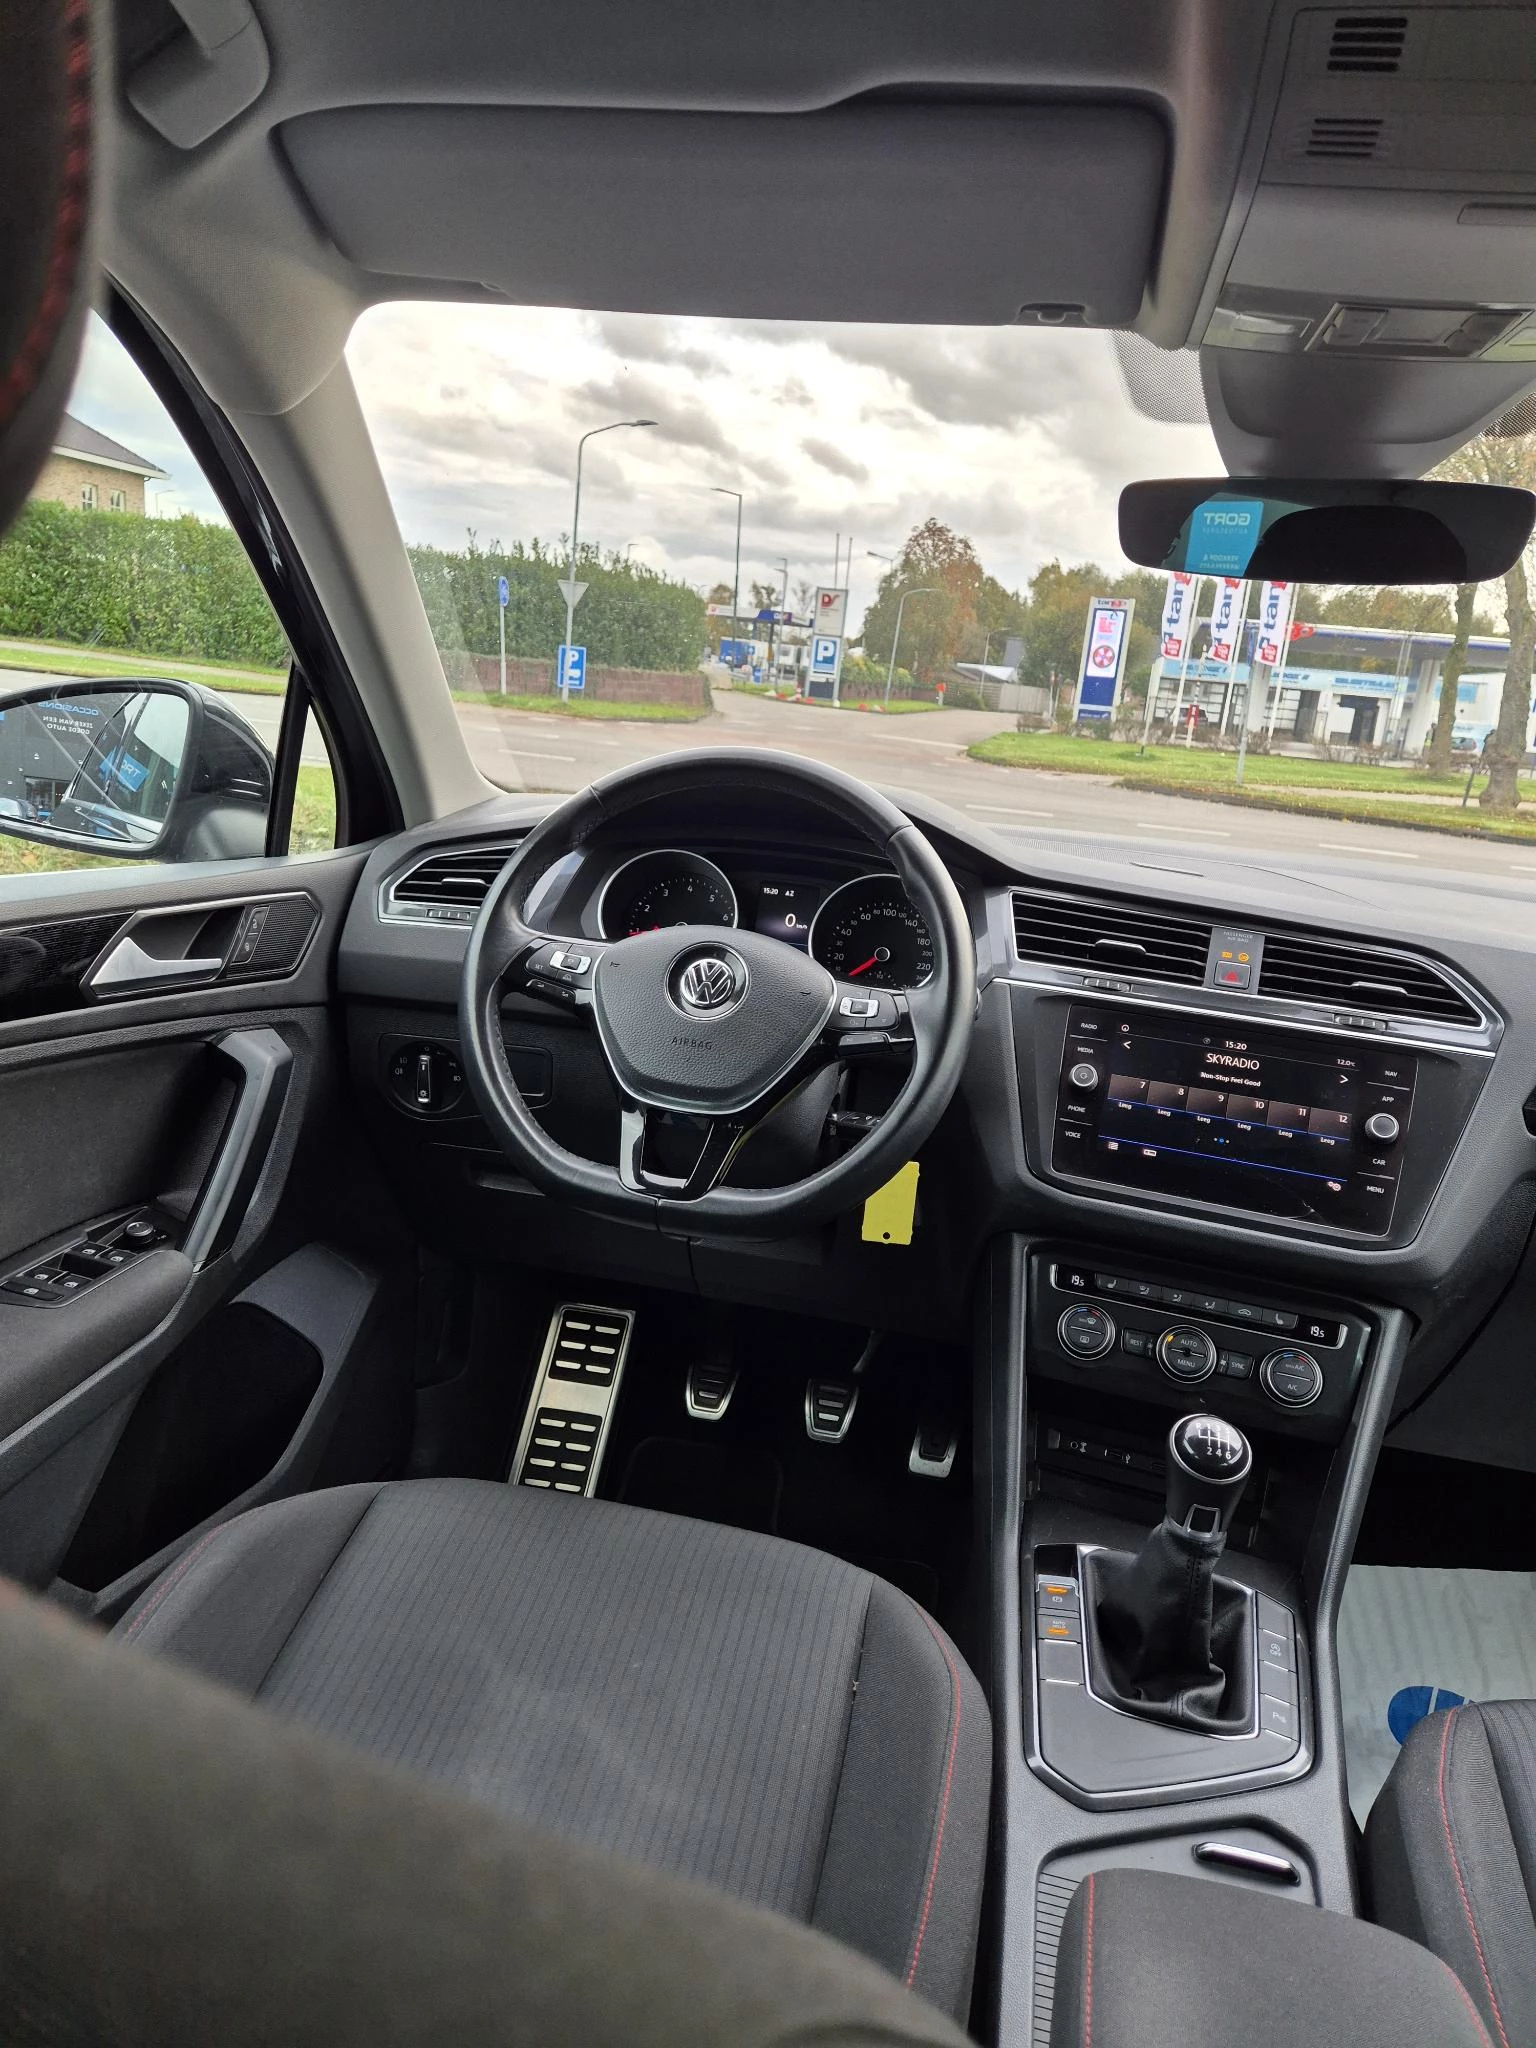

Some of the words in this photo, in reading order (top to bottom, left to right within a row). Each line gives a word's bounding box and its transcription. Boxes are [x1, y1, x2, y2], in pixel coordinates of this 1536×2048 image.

[817, 640, 836, 662] P
[663, 889, 669, 897] 3
[687, 885, 693, 893] 4
[644, 904, 650, 912] 2
[883, 908, 897, 917] 100
[785, 913, 796, 927] 0
[860, 913, 872, 921] 60
[904, 919, 918, 927] 140
[841, 928, 852, 936] 40
[917, 938, 931, 946] 180
[834, 953, 845, 961] 20
[916, 962, 931, 971] 220
[1080, 1022, 1098, 1030] RADIO
[671, 1036, 712, 1050] AIRBAG
[1225, 1040, 1248, 1051] 15:20
[1077, 1046, 1094, 1054] MEDIA
[1205, 1053, 1260, 1071] SKYRADIO
[1200, 1071, 1230, 1083] Non-Stop
[1244, 1078, 1261, 1087] Good
[1140, 1081, 1146, 1089] 7
[1178, 1088, 1184, 1096] 8
[1218, 1094, 1225, 1102] 9
[1255, 1101, 1265, 1109] 10
[1299, 1108, 1306, 1117] 11
[1339, 1114, 1348, 1123] 12
[1381, 1095, 1395, 1103] APP
[1067, 1104, 1086, 1113] PHONE
[1064, 1130, 1081, 1139] VOICE
[1372, 1158, 1386, 1166] CAR
[1366, 1185, 1385, 1194] MENU
[1130, 1338, 1143, 1346] REST
[1180, 1339, 1198, 1348] AUTO
[1177, 1358, 1196, 1368] MENU
[1231, 1361, 1246, 1370] SYNC
[1287, 1383, 1298, 1391] A/C
[1206, 1446, 1213, 1455] 2
[1215, 1448, 1222, 1457] 4
[1225, 1451, 1232, 1460] 6
